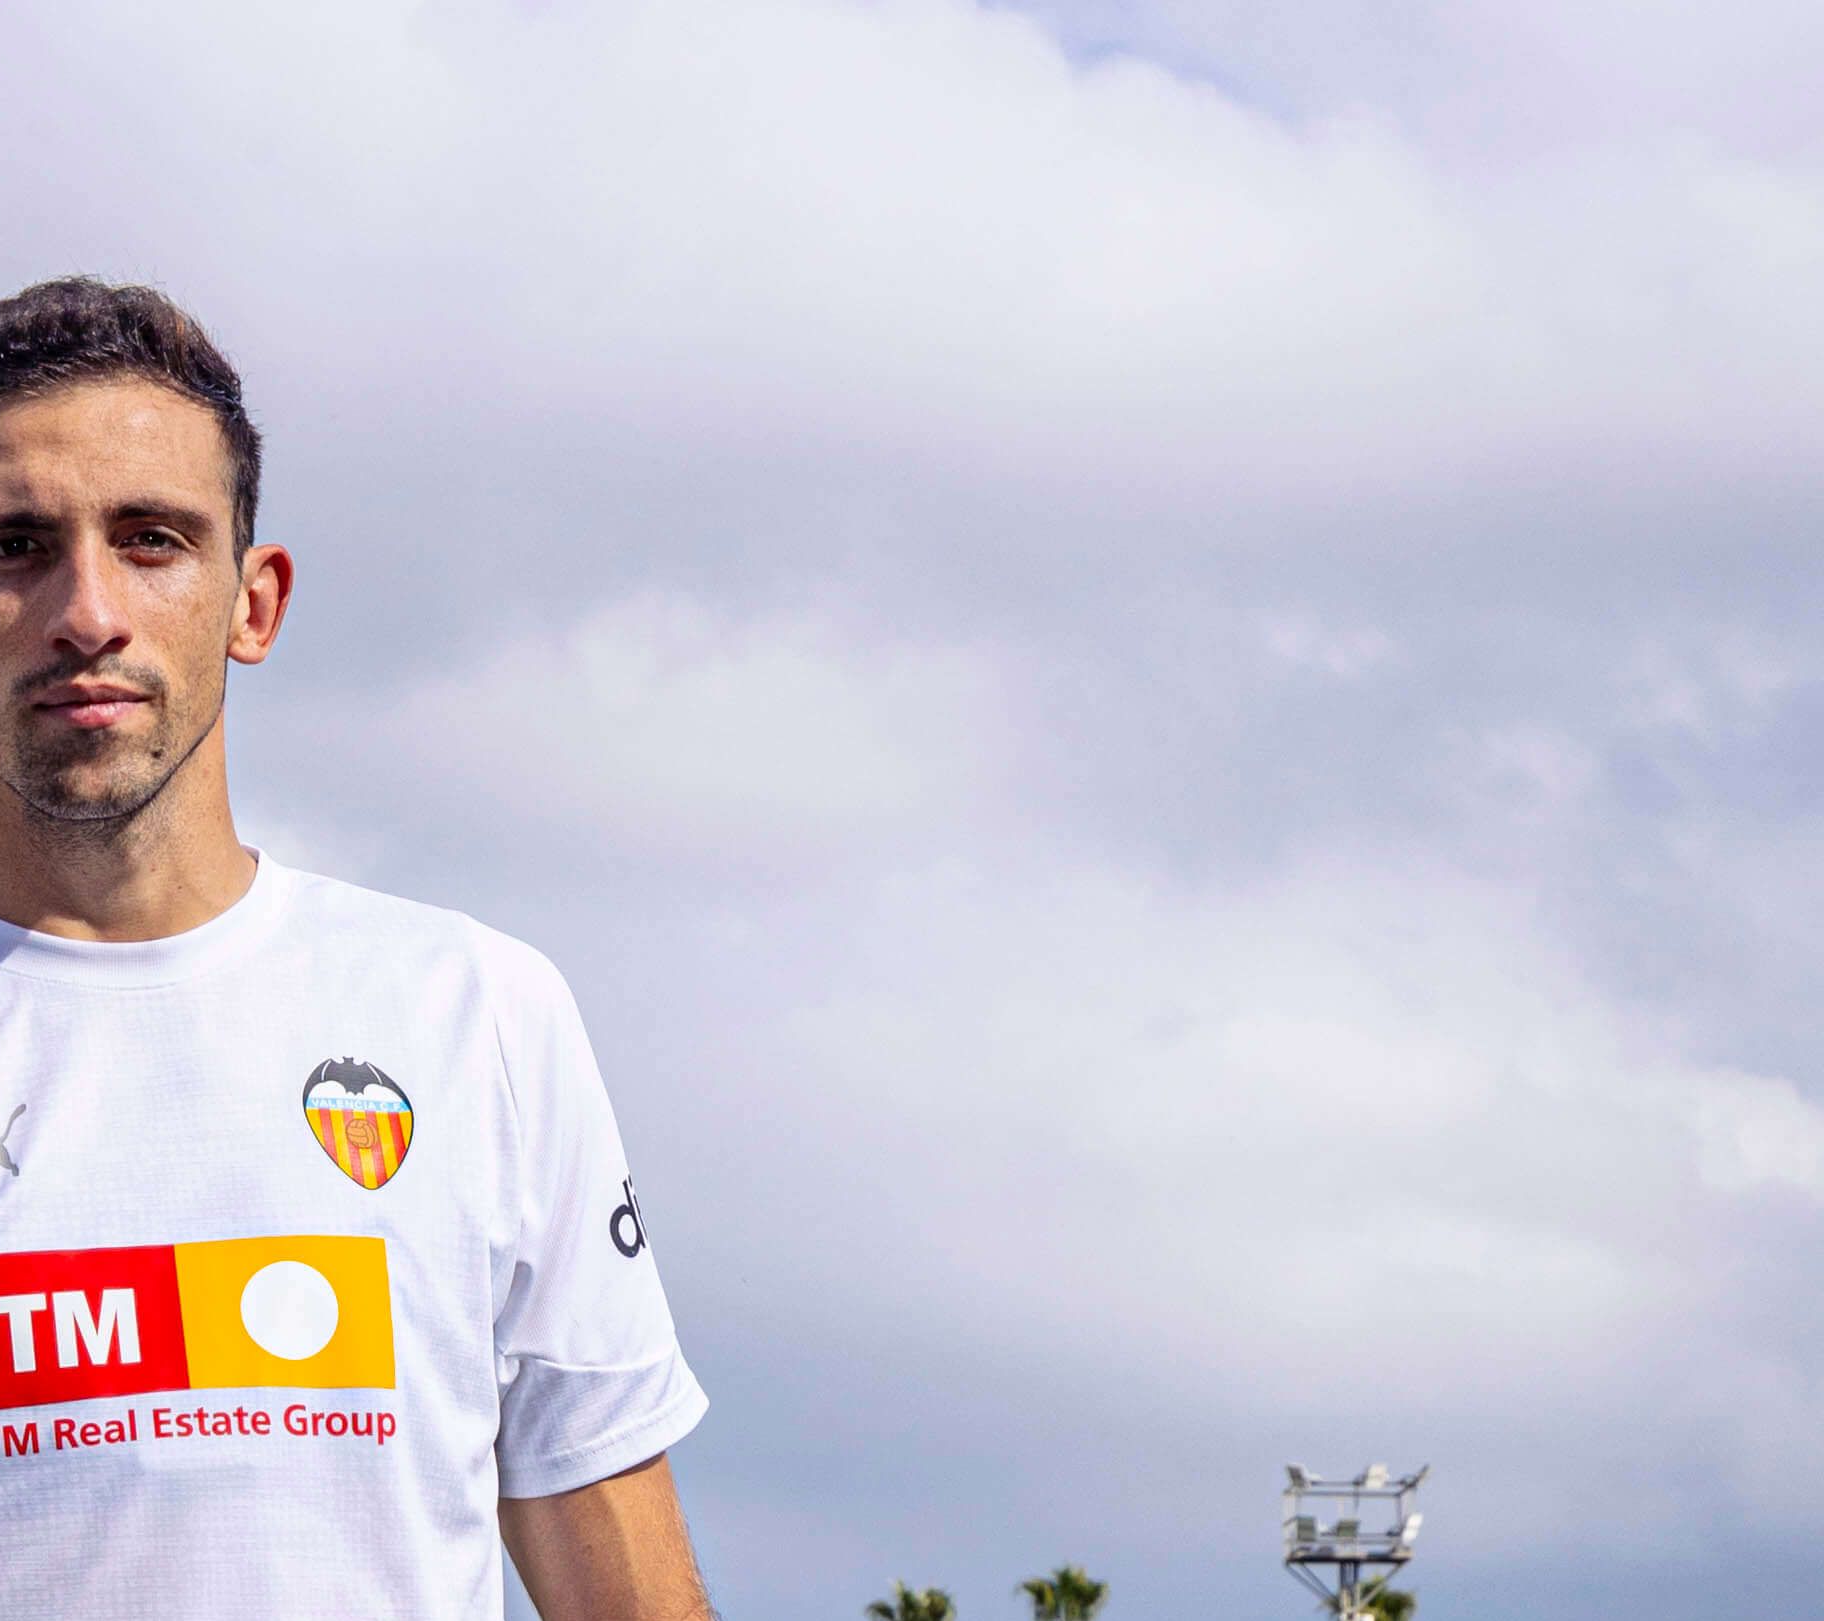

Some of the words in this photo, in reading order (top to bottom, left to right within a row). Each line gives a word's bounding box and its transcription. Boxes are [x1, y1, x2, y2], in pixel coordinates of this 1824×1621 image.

[53, 1410, 137, 1450] Real
[153, 1407, 271, 1438] Estate
[283, 1404, 396, 1445] Group
